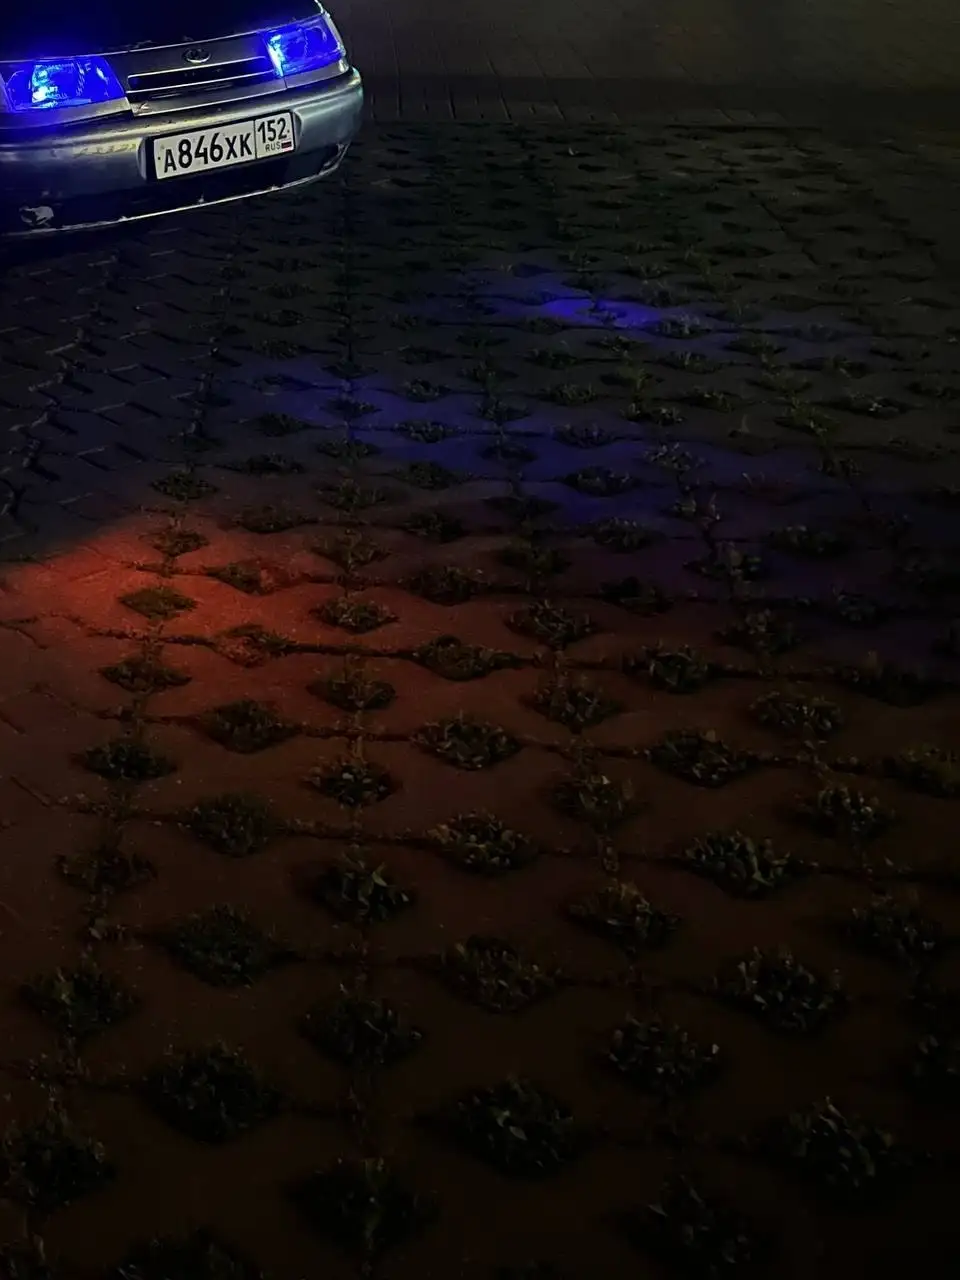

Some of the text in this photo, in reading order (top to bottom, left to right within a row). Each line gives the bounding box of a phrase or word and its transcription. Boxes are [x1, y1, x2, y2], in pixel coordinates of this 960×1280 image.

[164, 117, 288, 173] А846ХК 152
[265, 141, 281, 152] RUS
